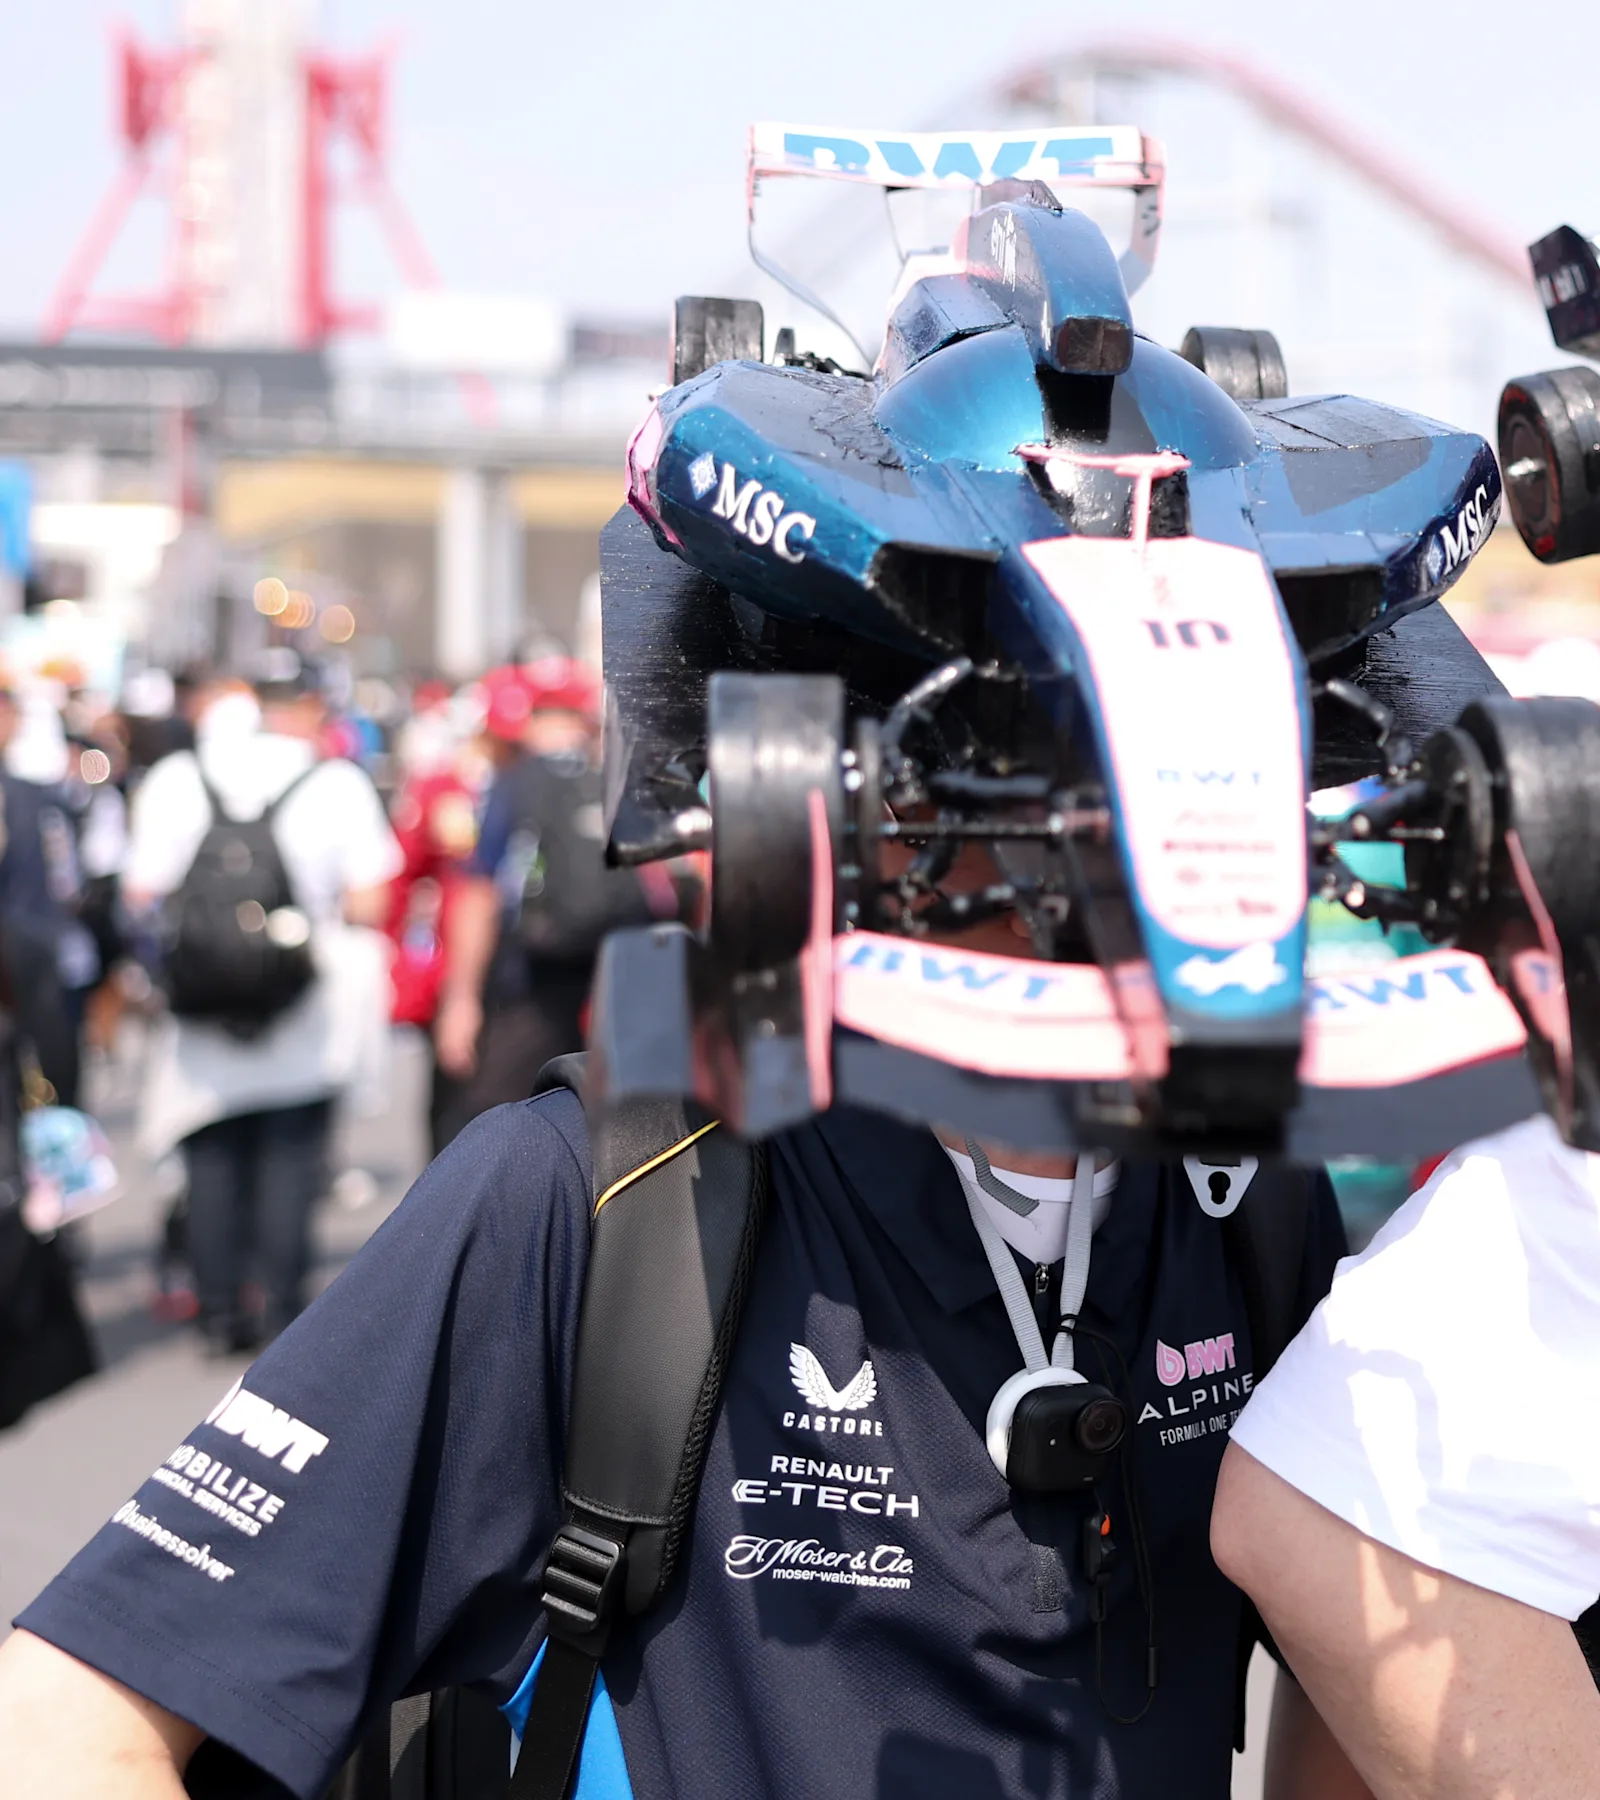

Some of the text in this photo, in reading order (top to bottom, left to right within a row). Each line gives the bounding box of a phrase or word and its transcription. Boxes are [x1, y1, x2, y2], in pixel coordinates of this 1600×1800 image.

[712, 462, 817, 564] MSC
[1440, 484, 1490, 576] MSC
[1184, 1332, 1236, 1380] BWT
[1137, 1372, 1254, 1424] ALPINE
[213, 1388, 330, 1474] BWT
[783, 1411, 883, 1436] CASTORE
[1160, 1420, 1207, 1446] FORMULA
[1209, 1414, 1228, 1433] ONE
[770, 1455, 894, 1485] RENAULT
[192, 1487, 263, 1538] SERVICES
[732, 1479, 920, 1518] E-TECH
[123, 1504, 236, 1582] businessolver
[766, 1539, 851, 1570] Moser
[850, 1550, 867, 1571] &
[772, 1566, 911, 1589] moser-watches.com
